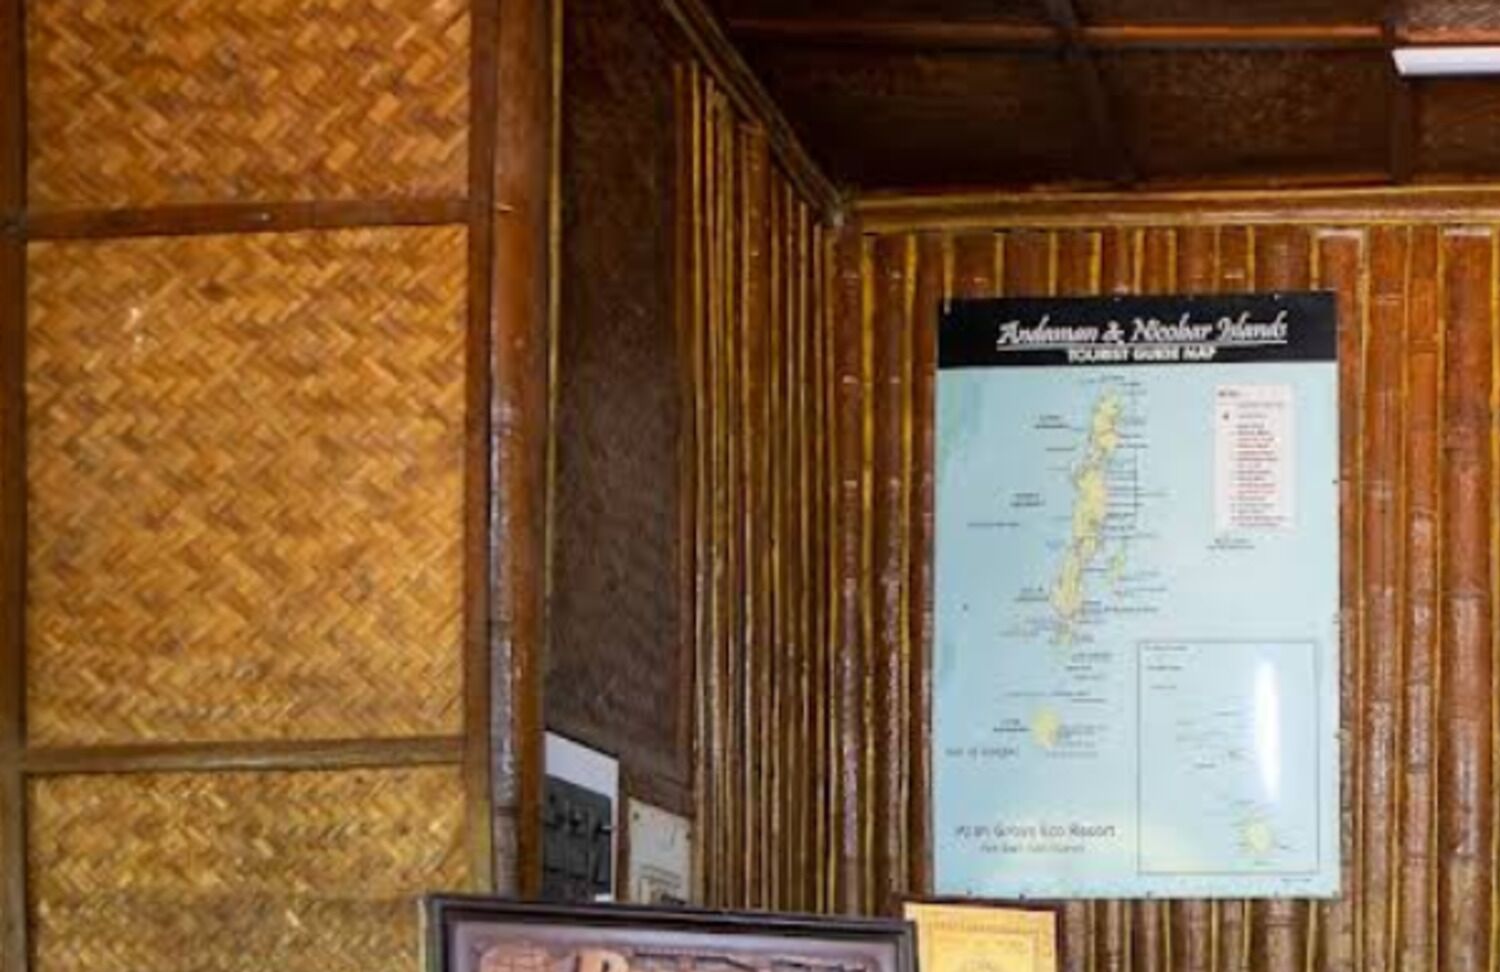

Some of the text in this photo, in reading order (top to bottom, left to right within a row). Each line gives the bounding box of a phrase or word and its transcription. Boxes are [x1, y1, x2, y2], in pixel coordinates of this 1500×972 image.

[997, 310, 1288, 345] Andaman & Nicobar Islands
[1068, 344, 1217, 361] TOURIST GUIDE MAP
